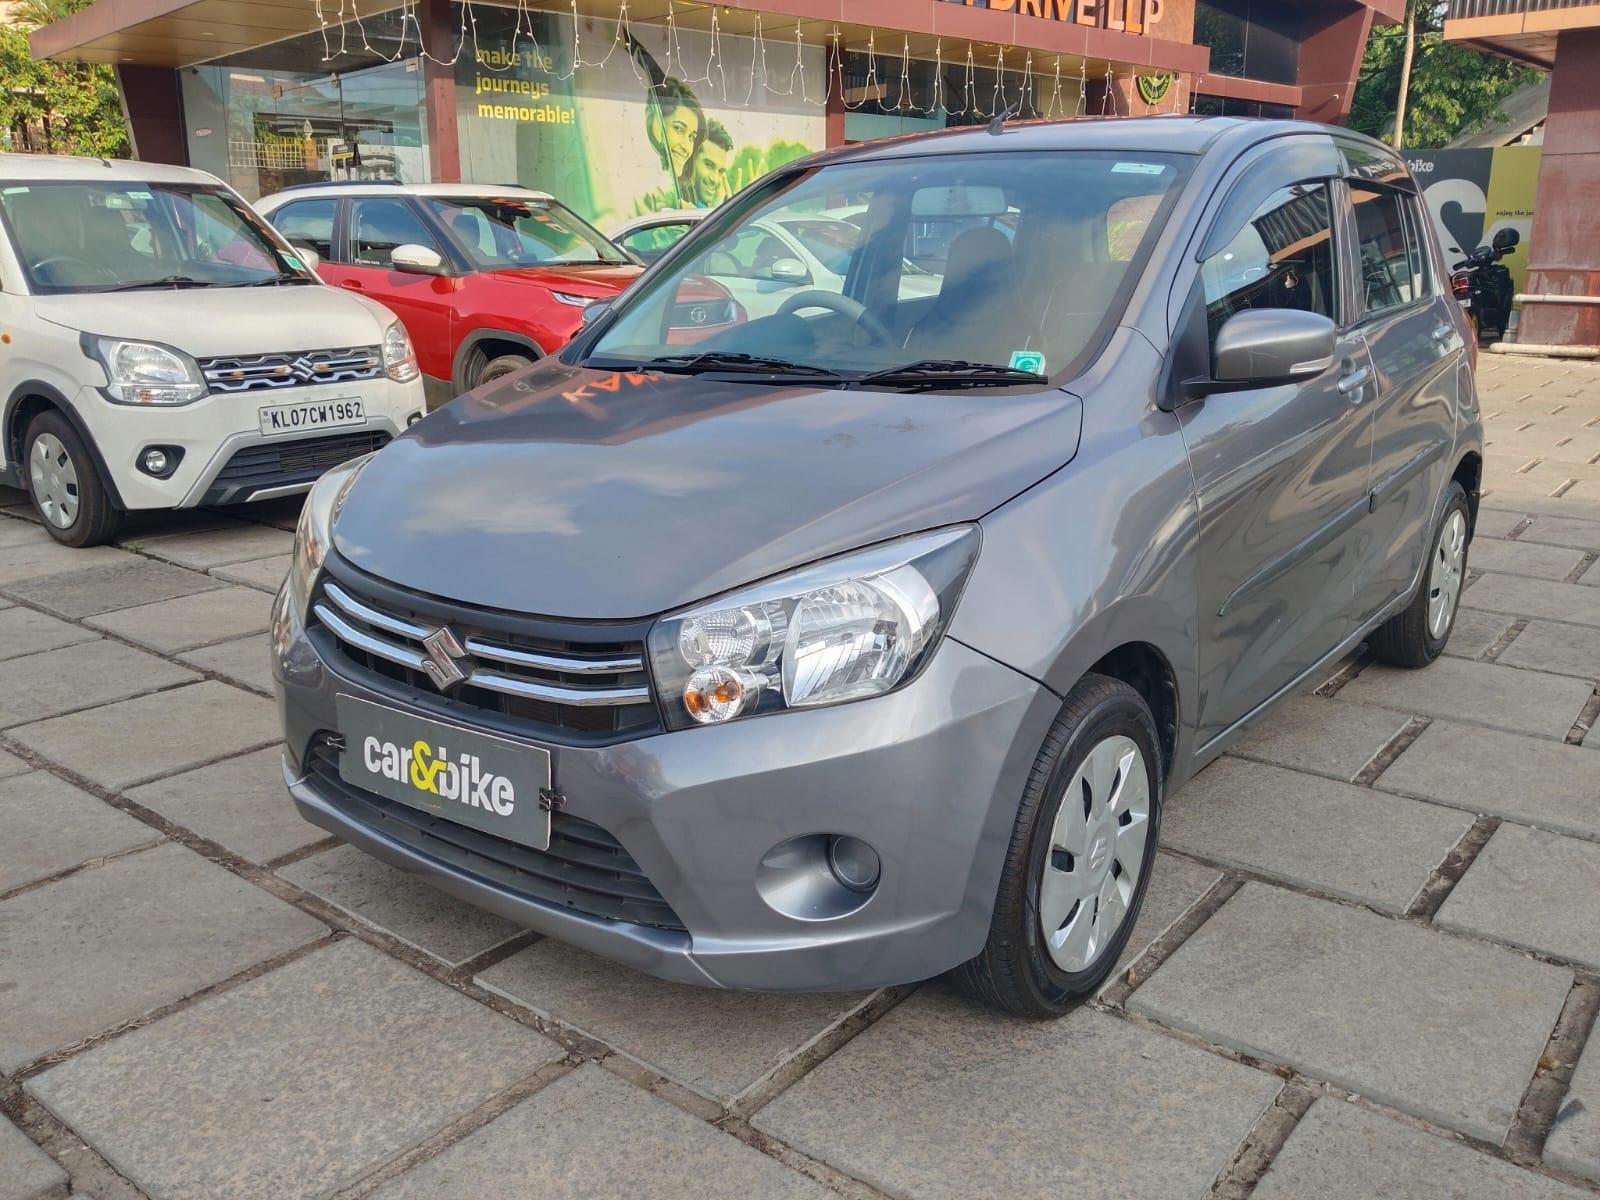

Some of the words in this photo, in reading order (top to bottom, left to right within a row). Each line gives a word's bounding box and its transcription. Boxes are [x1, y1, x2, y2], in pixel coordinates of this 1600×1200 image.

[989, 0, 1096, 26] RIVE
[1107, 0, 1164, 34] LLP
[476, 47, 520, 66] make
[526, 50, 553, 70] the
[475, 72, 549, 98] journeys
[478, 103, 575, 124] memorable!
[271, 401, 363, 429] KL07CW1962
[364, 736, 515, 817] car&bike
